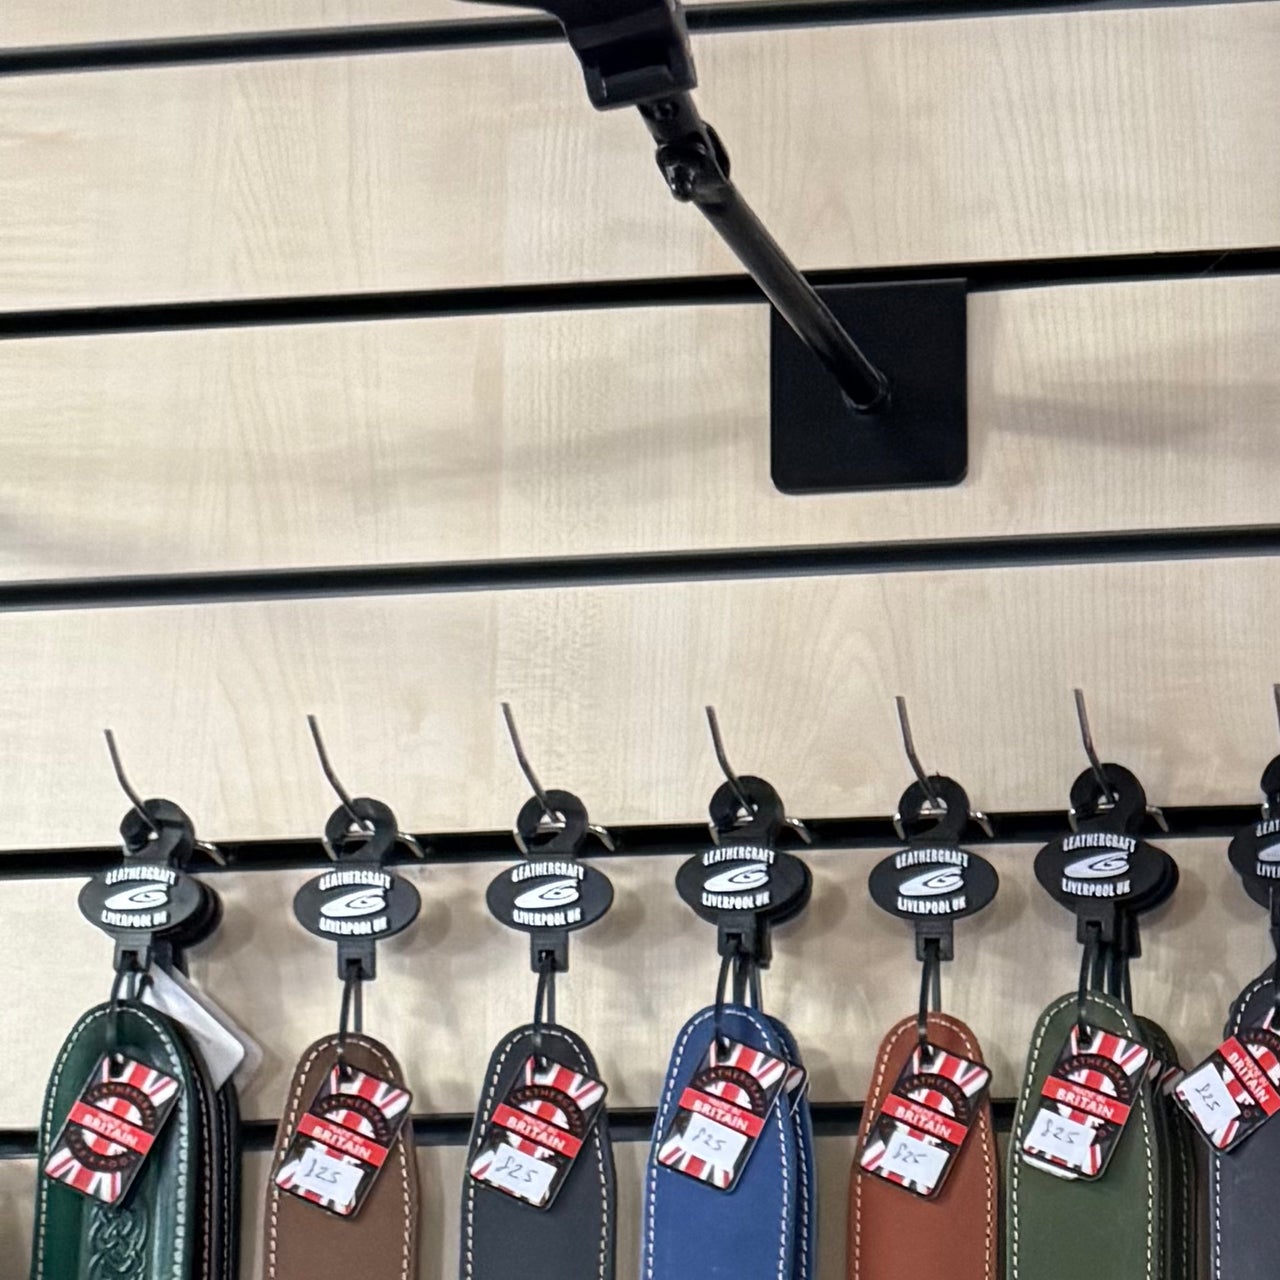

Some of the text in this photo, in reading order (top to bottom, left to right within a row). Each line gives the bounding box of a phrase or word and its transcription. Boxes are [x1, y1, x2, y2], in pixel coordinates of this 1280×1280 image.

[1062, 878, 1115, 896] LIVERPOOL
[1225, 1051, 1270, 1103] BRITAIN
[692, 1098, 748, 1131] BRITAIN
[1055, 1087, 1114, 1118] BRITAIN
[81, 1112, 139, 1146] BRITAIN
[505, 1116, 565, 1151] BRITAIN
[893, 1106, 951, 1139] BRITAIN
[311, 1125, 371, 1159] BRITAIN
